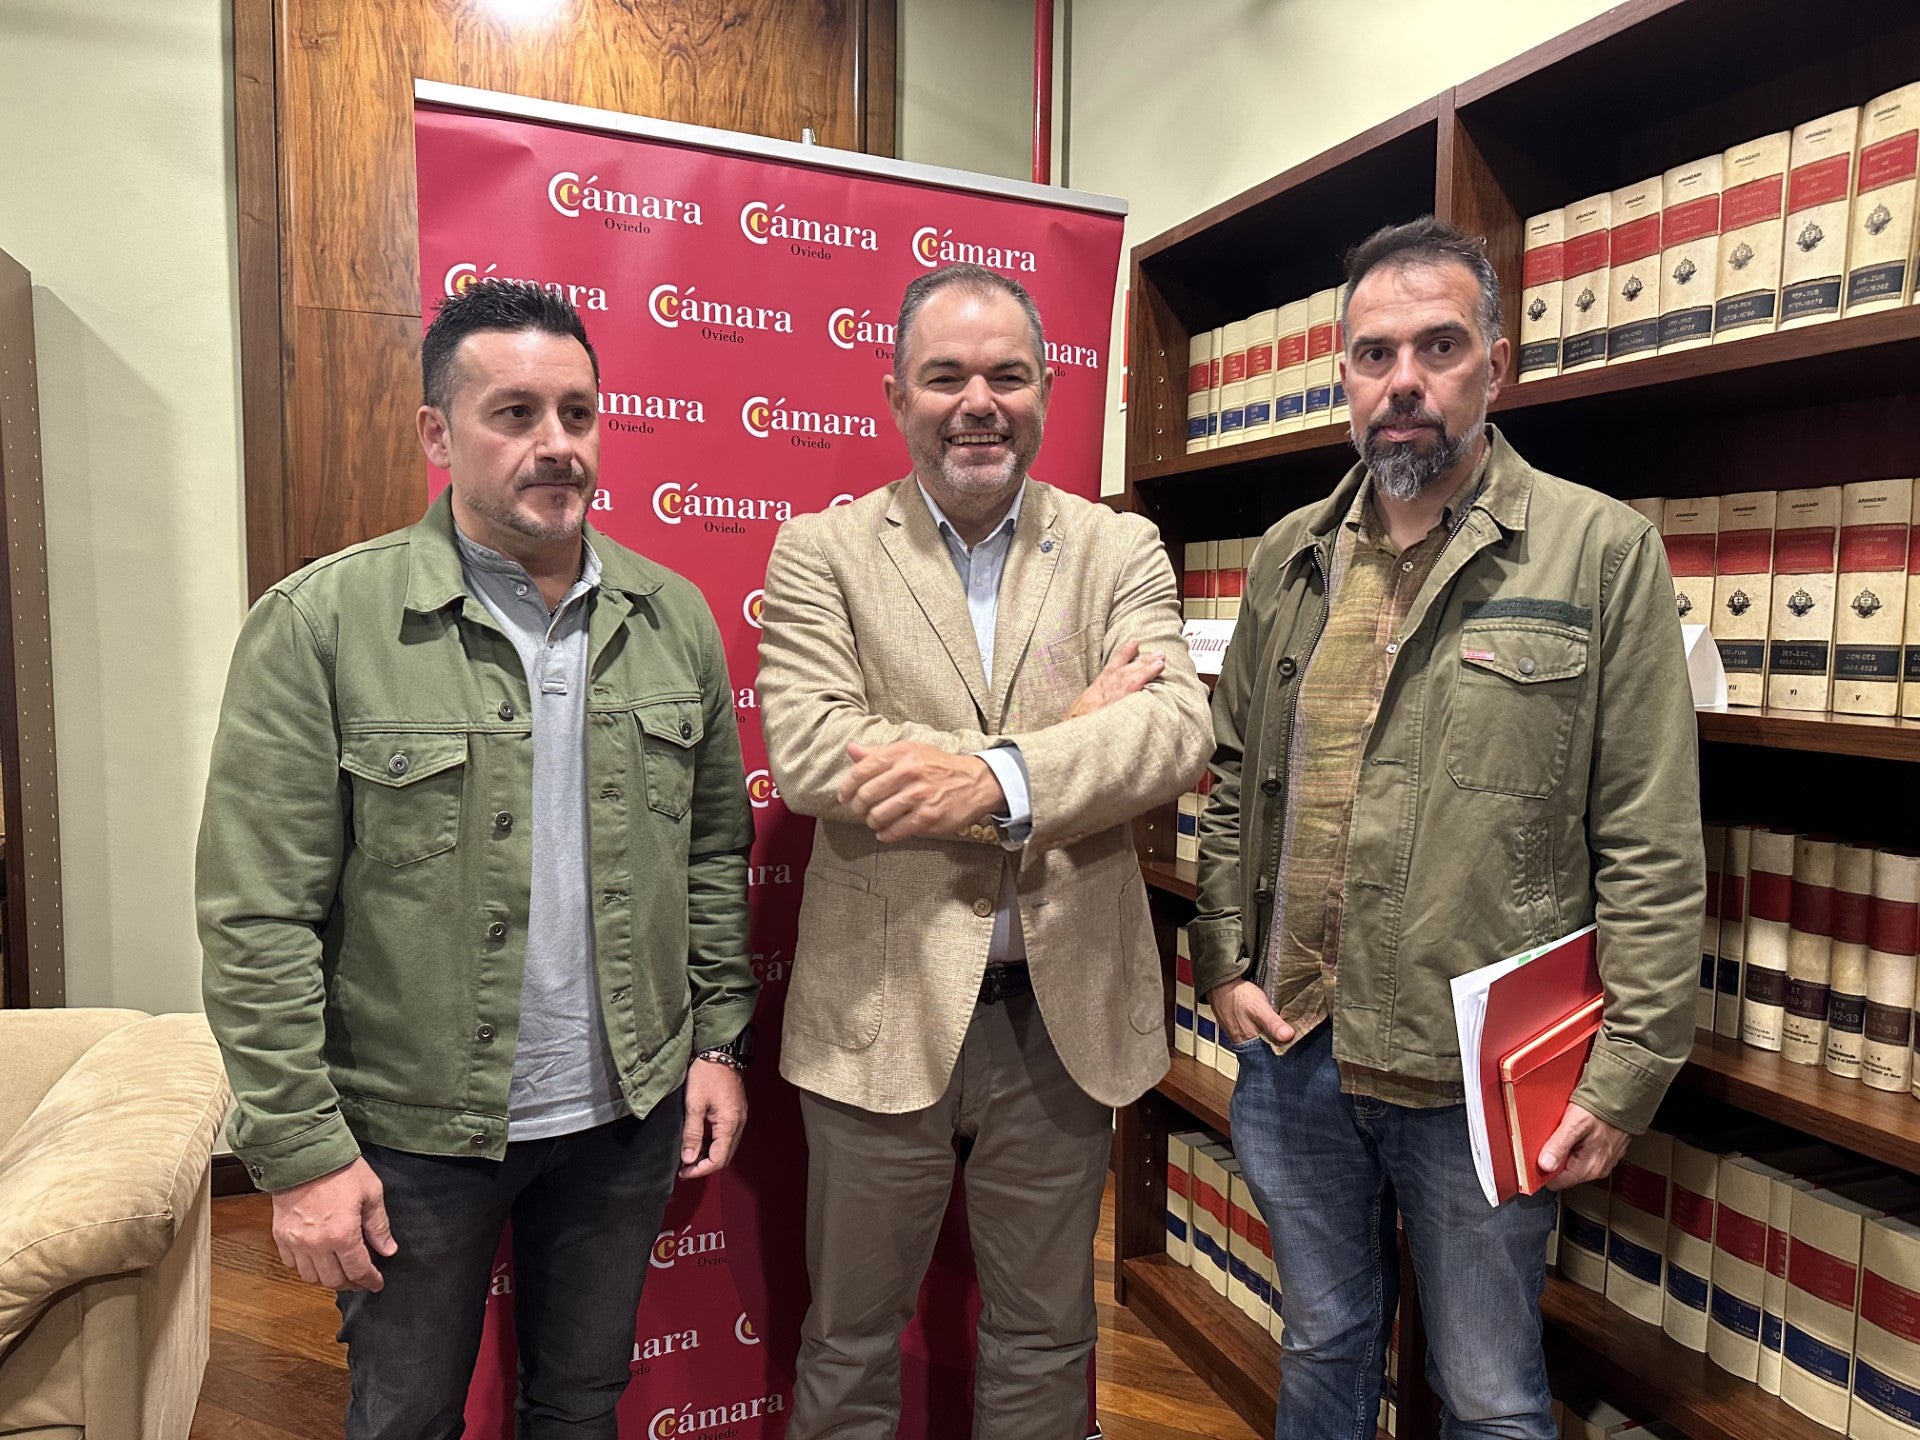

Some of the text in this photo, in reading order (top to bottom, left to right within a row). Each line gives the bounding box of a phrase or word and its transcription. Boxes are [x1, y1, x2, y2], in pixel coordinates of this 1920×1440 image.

[548, 171, 703, 227] Cámara
[604, 217, 651, 235] Oviedo
[740, 201, 879, 251] Cámara
[790, 243, 832, 261] Oviedo
[912, 226, 1037, 273] Cámara
[649, 284, 793, 334] Cámara
[828, 307, 898, 349] Cám
[701, 327, 745, 344] Oviedo
[608, 418, 655, 435] Oviedo
[742, 396, 878, 438] Cámara
[790, 435, 832, 450] Oviedo
[652, 482, 793, 524] Cámara
[704, 521, 746, 535] Oviedo
[649, 1224, 726, 1269] Cám
